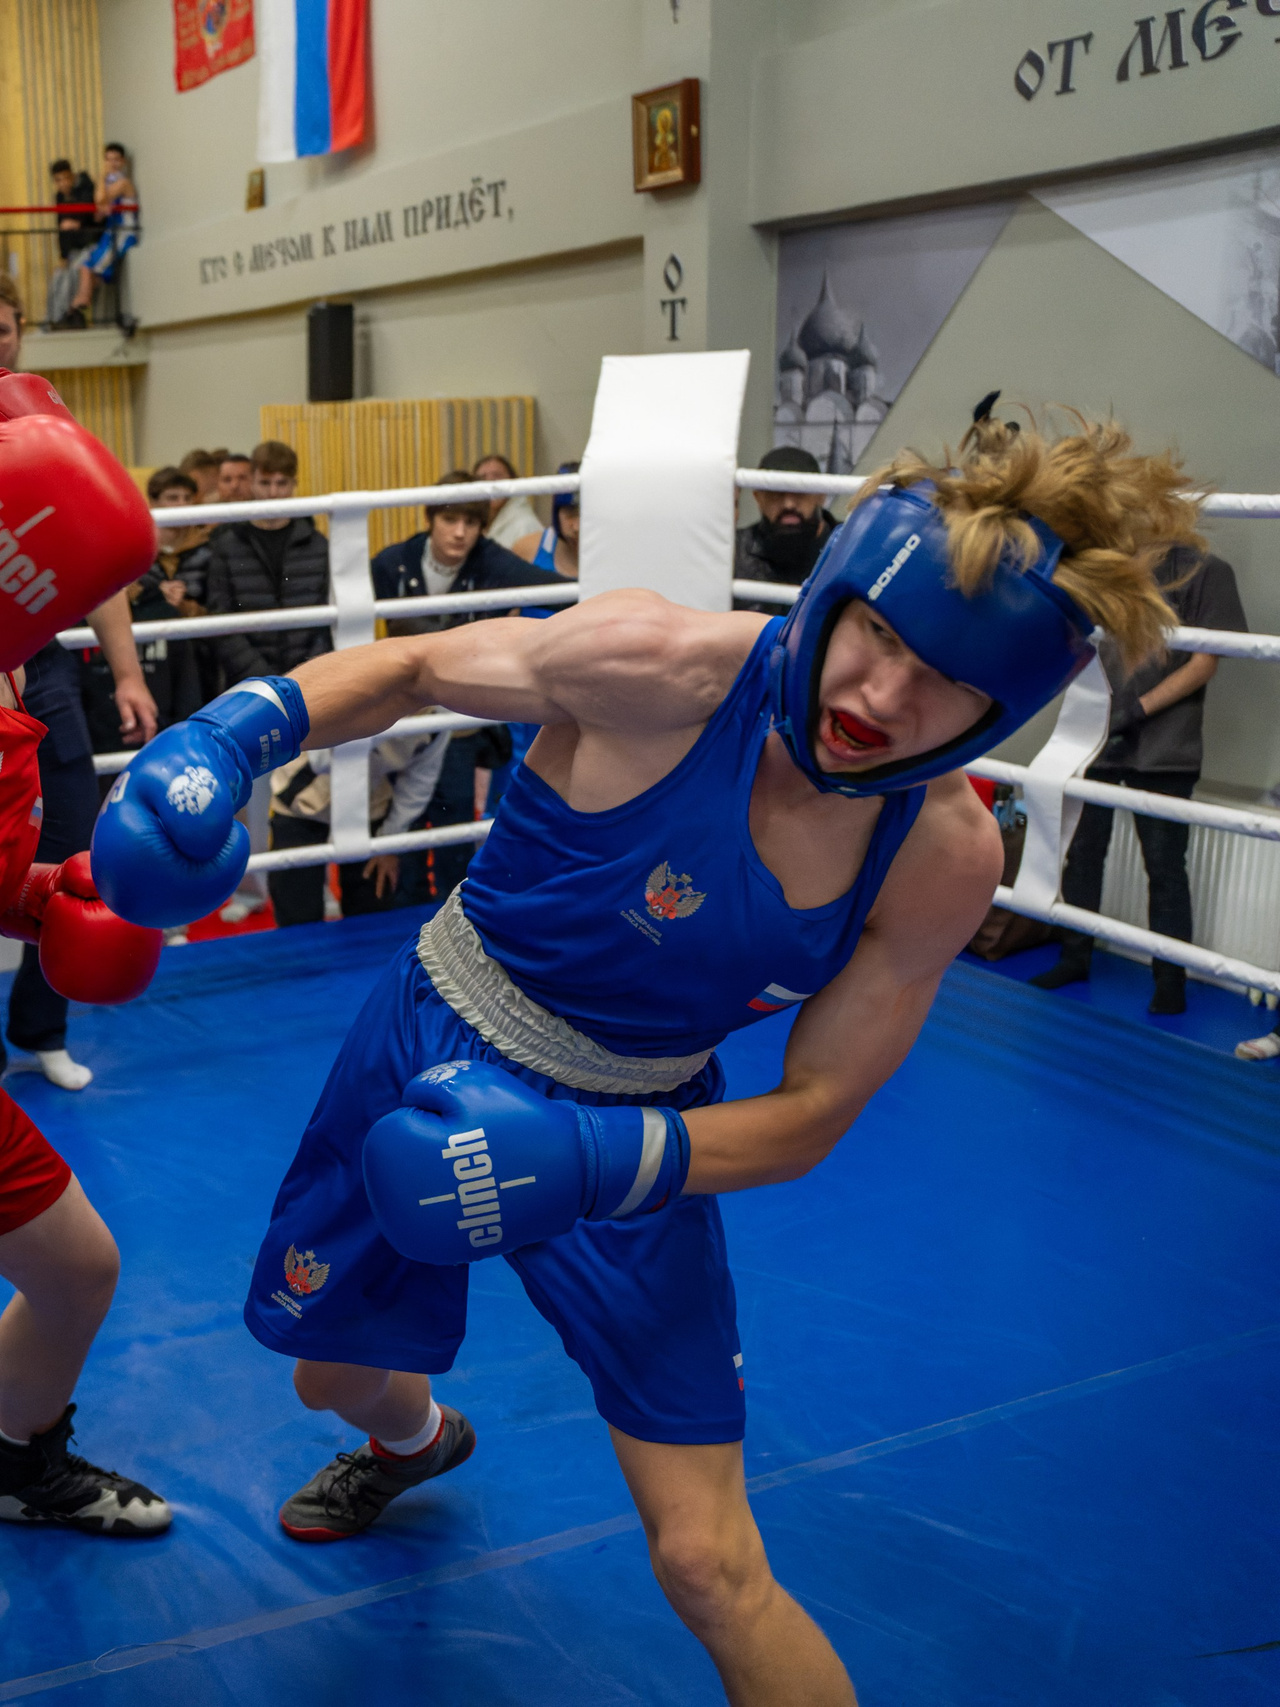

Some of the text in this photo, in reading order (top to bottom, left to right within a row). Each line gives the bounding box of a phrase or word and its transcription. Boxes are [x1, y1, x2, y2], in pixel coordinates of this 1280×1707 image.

[1014, 0, 1280, 101] ОТ МЕ
[200, 255, 228, 285] КТО
[250, 232, 315, 272] МЕЧОМ
[322, 224, 337, 257] К
[343, 210, 395, 252] НАМ
[402, 176, 514, 238] ПРИДЁТ,
[441, 1127, 504, 1249] clinch
